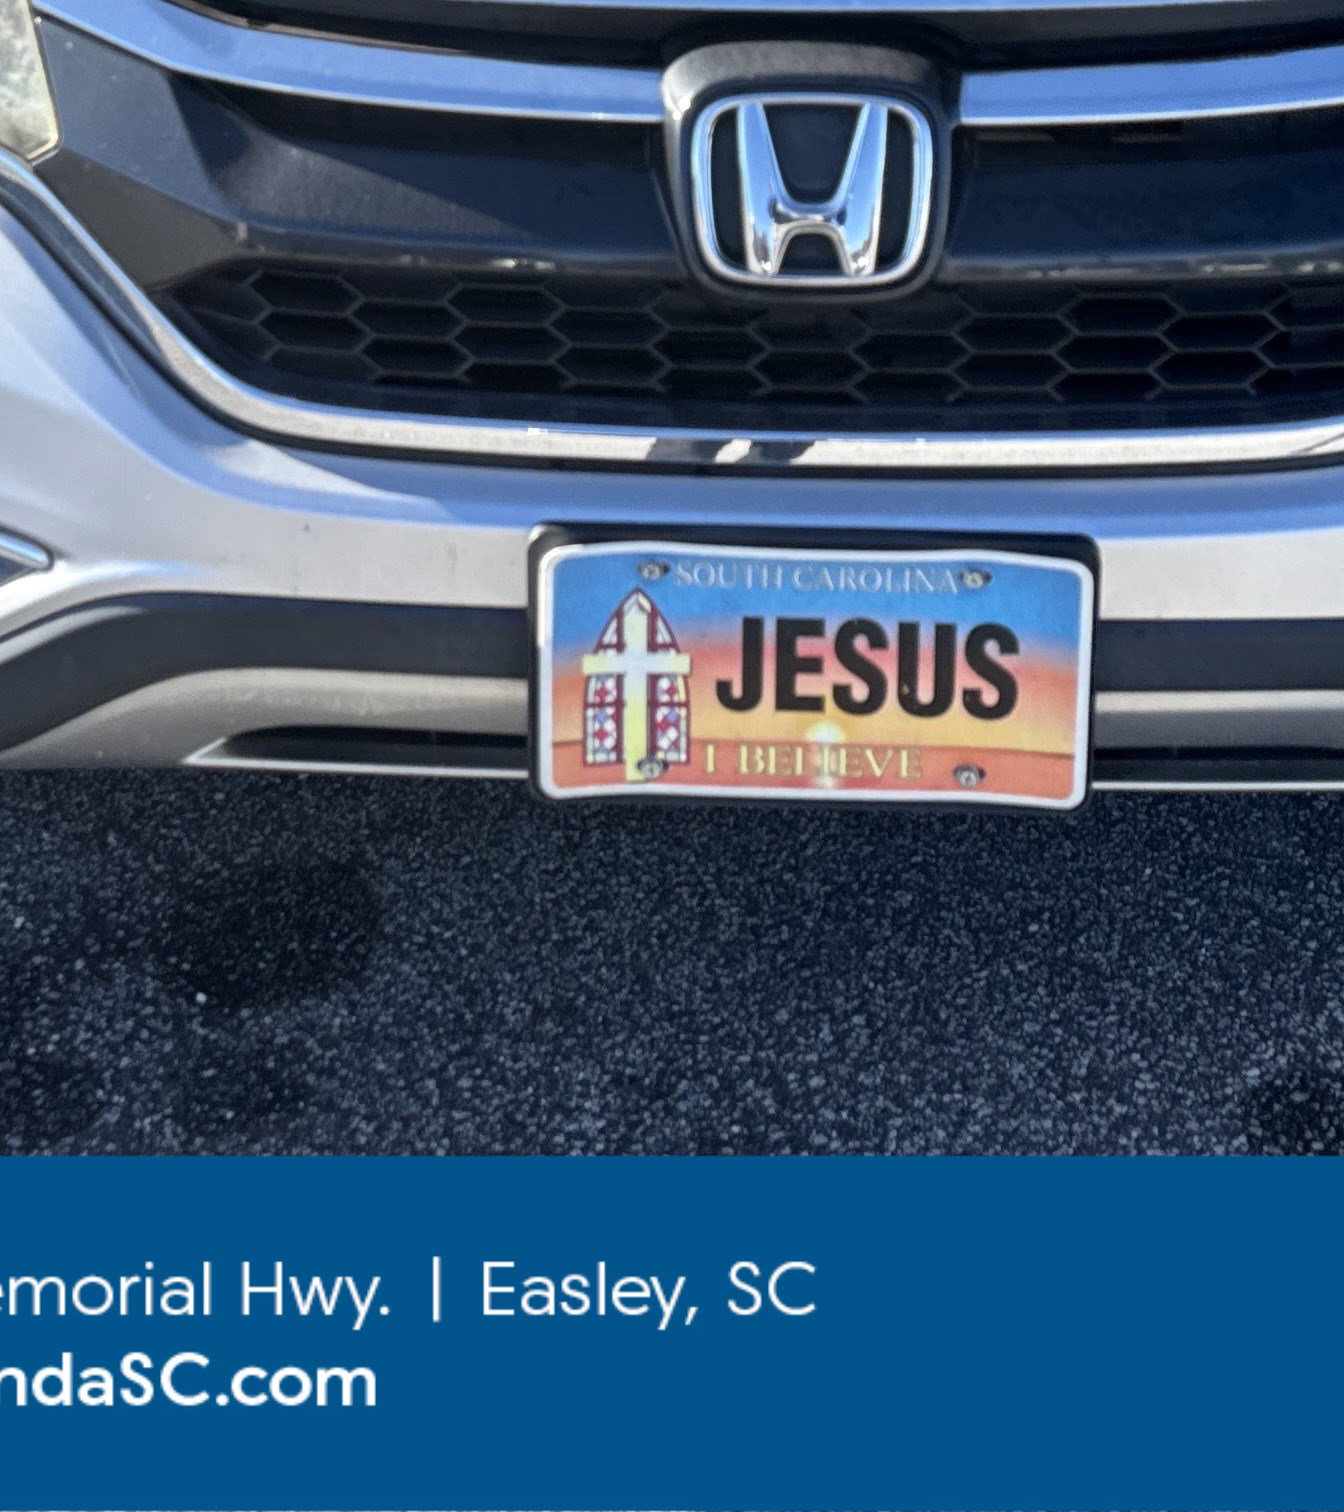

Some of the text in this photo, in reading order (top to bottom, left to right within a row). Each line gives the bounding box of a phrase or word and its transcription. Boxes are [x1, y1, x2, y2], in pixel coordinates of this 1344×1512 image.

[674, 559, 959, 596] SOUTH CAROLINA
[714, 615, 1020, 722] JESUS
[705, 745, 923, 779] I BELIEVE
